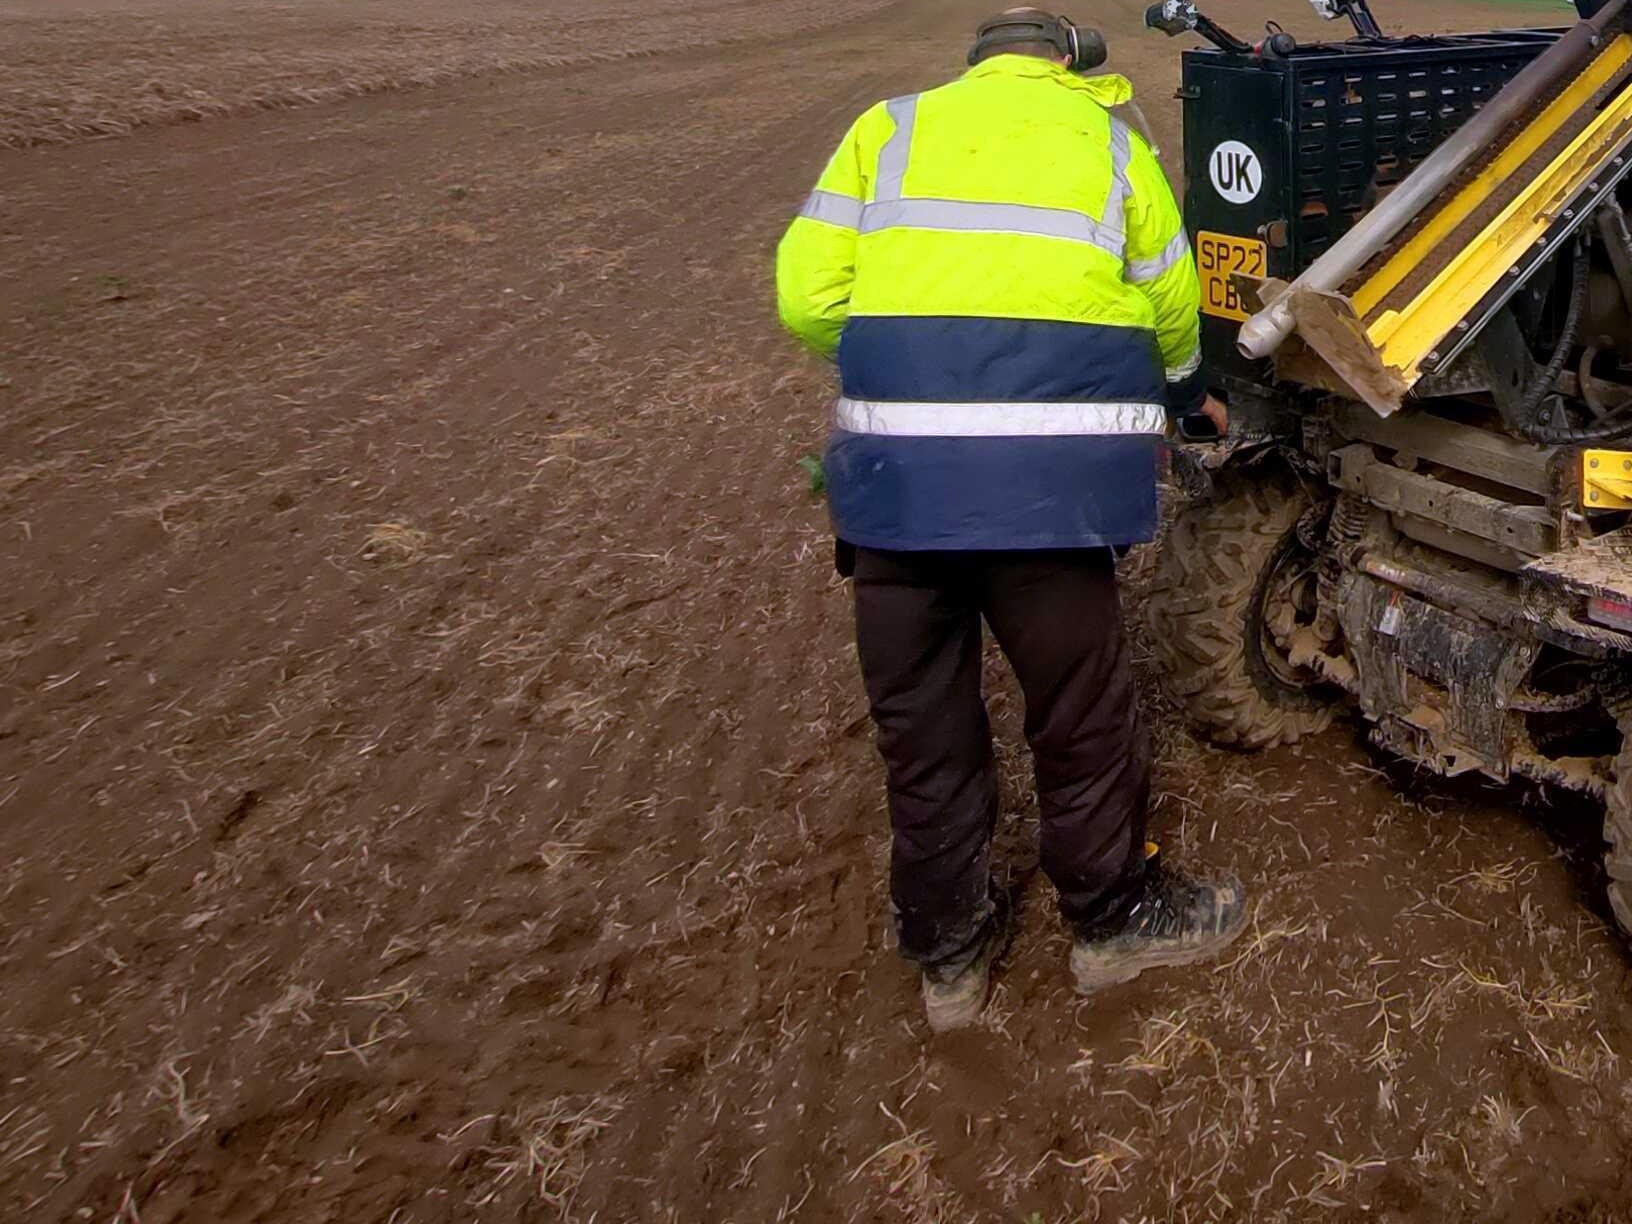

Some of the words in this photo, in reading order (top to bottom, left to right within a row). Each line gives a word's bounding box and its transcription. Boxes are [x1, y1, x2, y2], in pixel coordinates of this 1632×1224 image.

[1216, 151, 1255, 194] UK
[1201, 239, 1263, 274] SP22
[1208, 276, 1249, 313] CB
